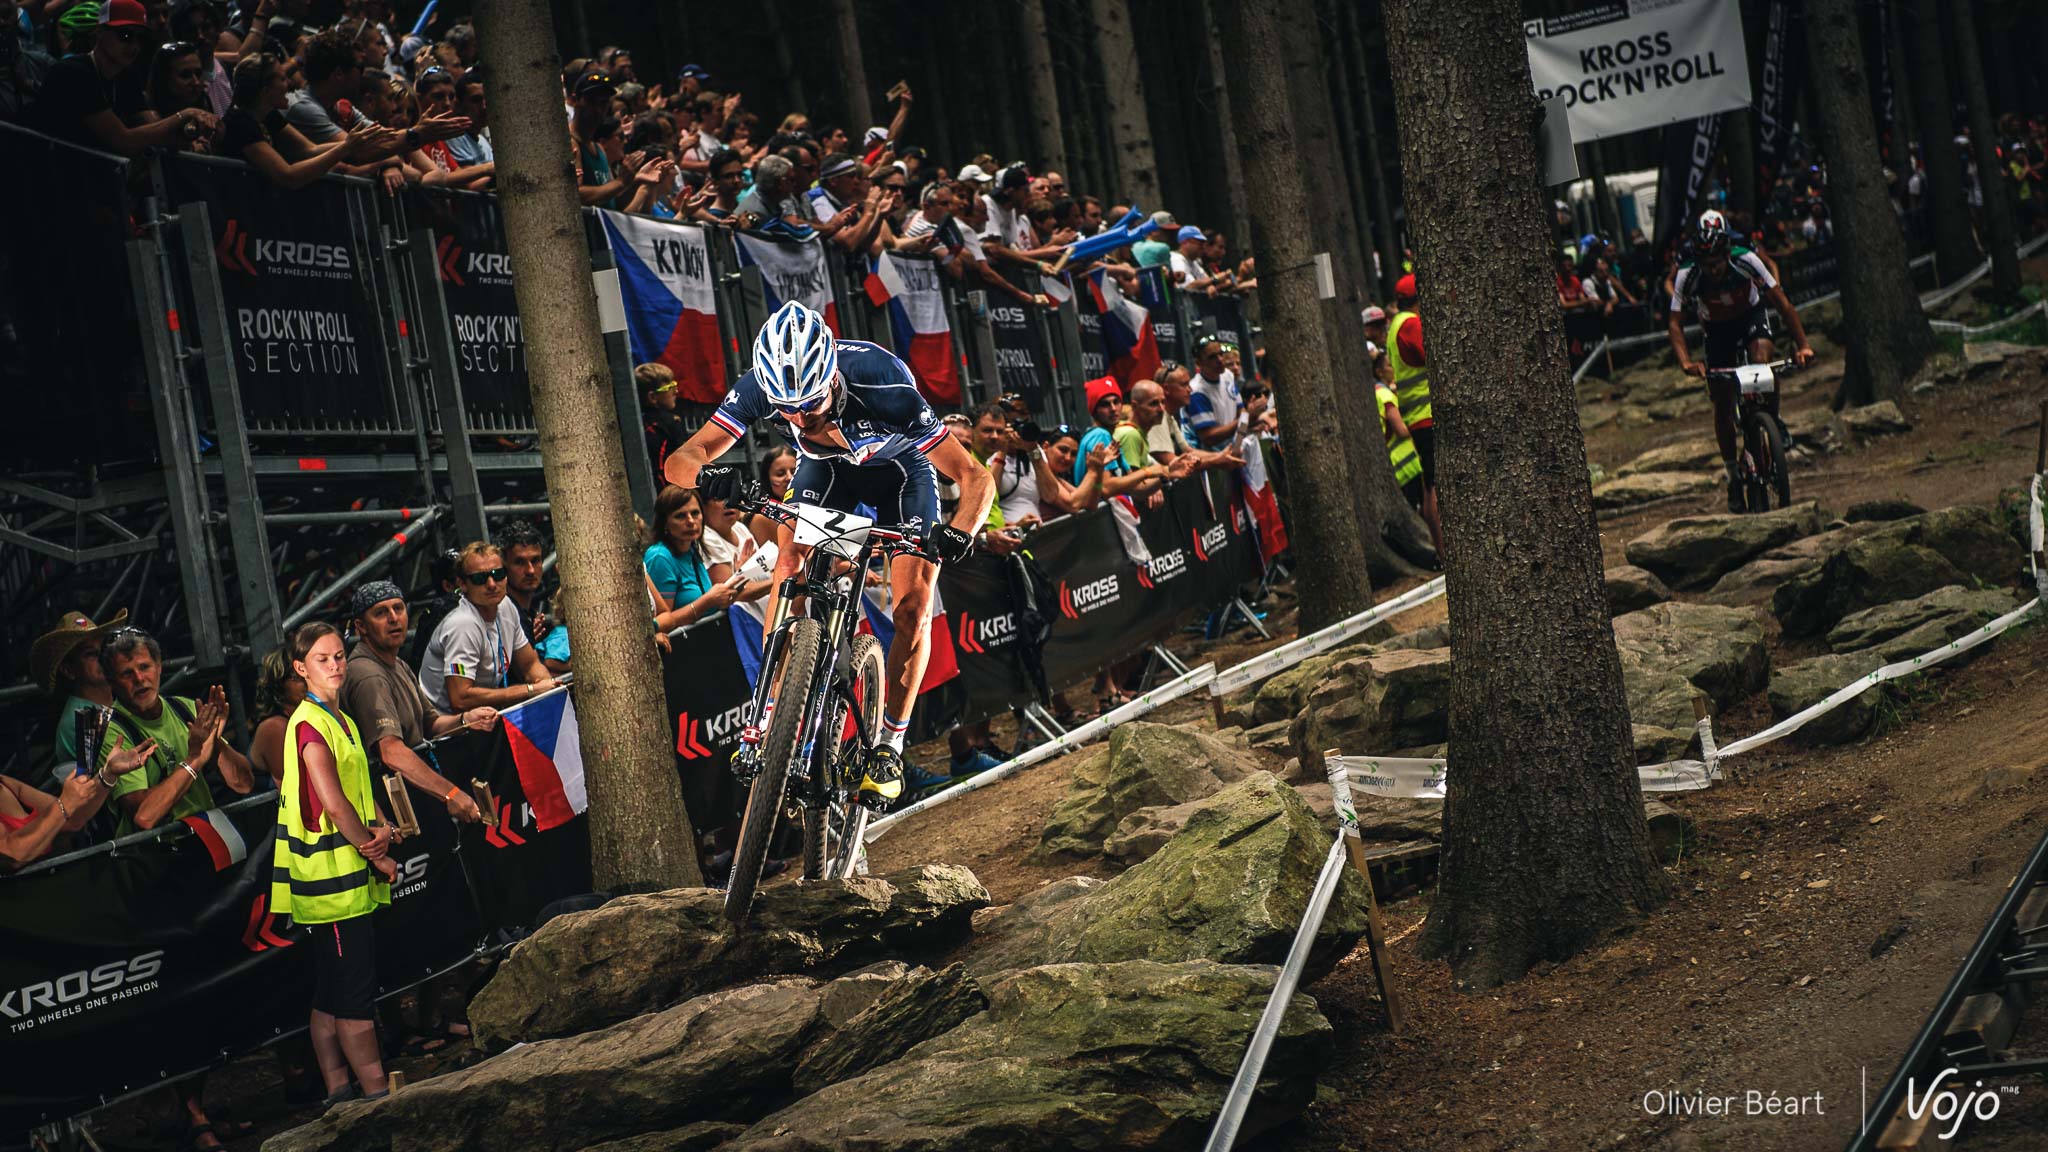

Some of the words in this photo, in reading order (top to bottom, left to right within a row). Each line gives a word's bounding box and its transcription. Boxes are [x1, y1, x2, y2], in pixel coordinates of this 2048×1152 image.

[1523, 22, 1542, 38] CI
[1580, 31, 1672, 74] KROSS
[256, 238, 351, 269] KROSS
[238, 308, 355, 344] ROCK'N'ROLL
[243, 342, 360, 375] SECTION
[824, 509, 847, 534] 2
[1149, 548, 1185, 578] KROSS
[1072, 574, 1119, 608] KROSS
[0, 950, 165, 1018] KROSS
[10, 1019, 35, 1033] TWO
[38, 1004, 82, 1025] WHEELS
[86, 996, 108, 1010] ONE
[111, 980, 159, 1002] PASSION
